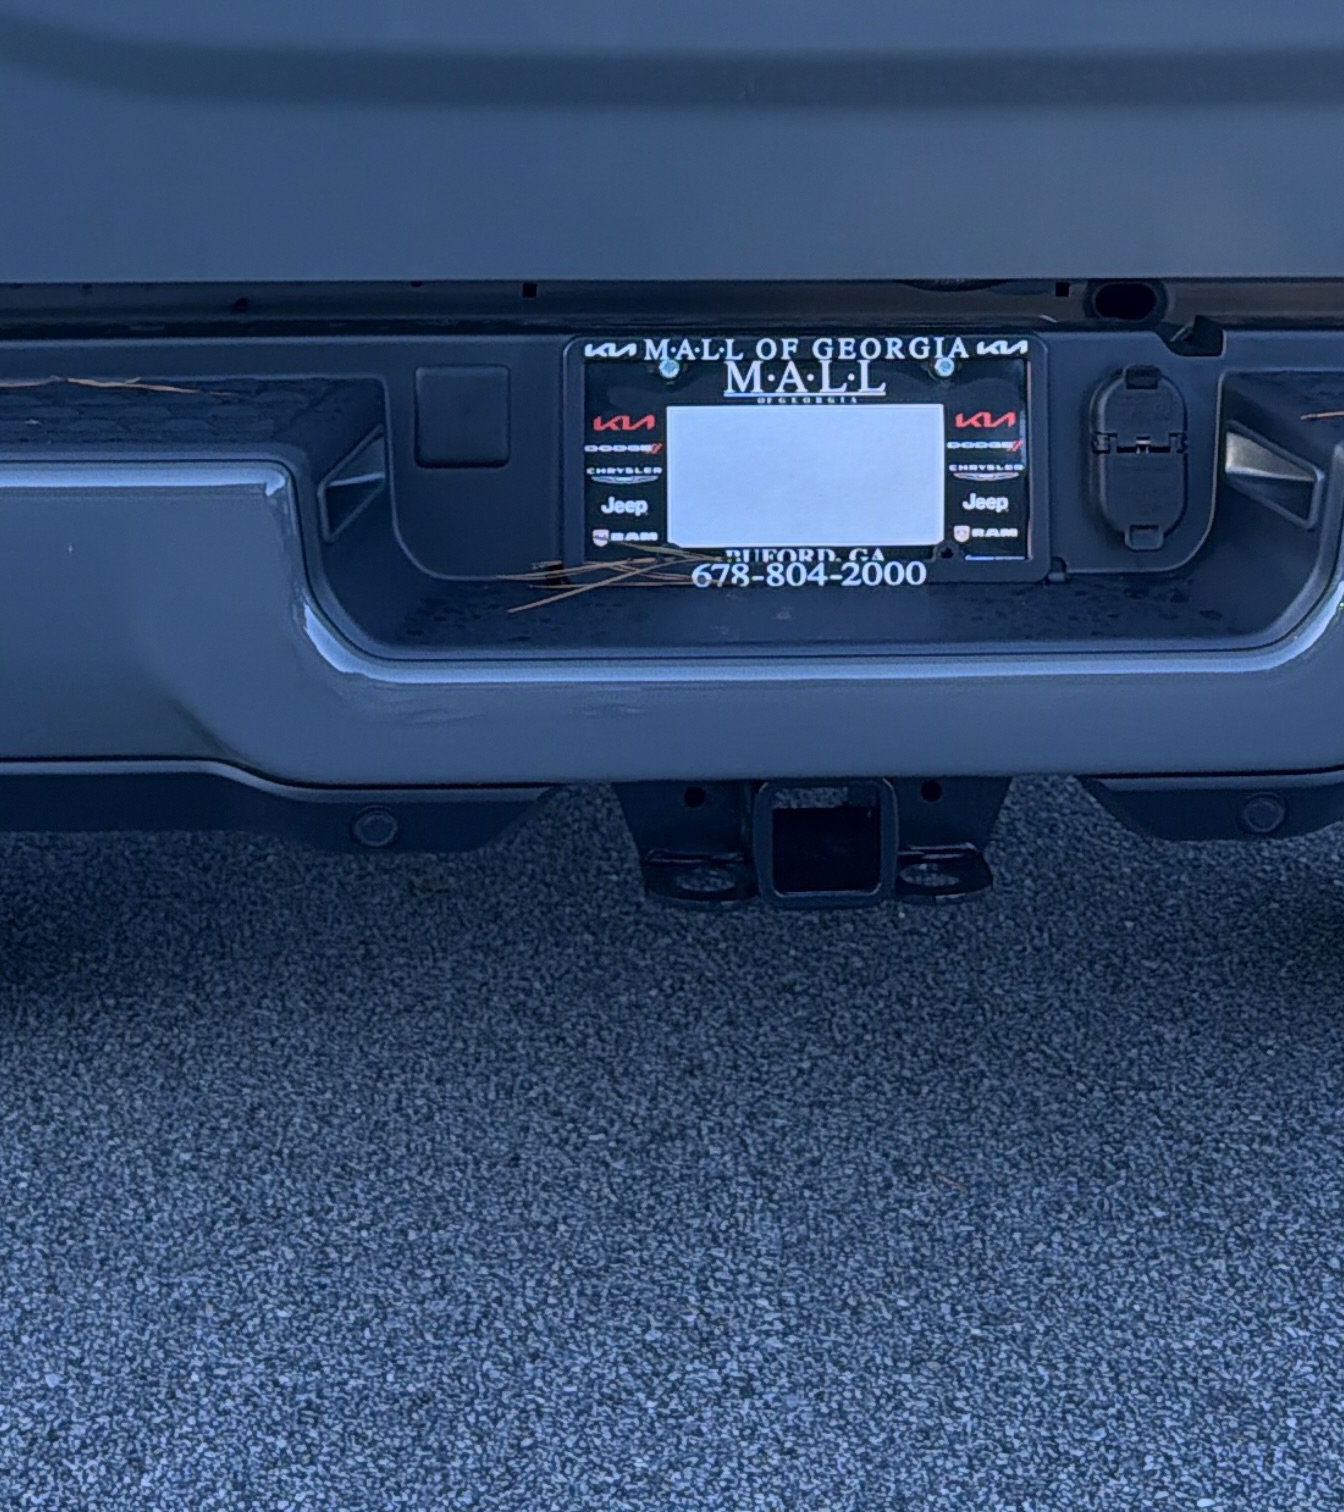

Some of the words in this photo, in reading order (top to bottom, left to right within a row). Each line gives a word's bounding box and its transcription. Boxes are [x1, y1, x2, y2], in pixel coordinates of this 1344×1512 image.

[756, 337, 799, 360] OF
[812, 336, 970, 360] GEORGIA
[586, 467, 663, 475] CHRYSLER
[600, 495, 649, 517] Jeep
[962, 492, 1009, 513] Jeep
[610, 532, 659, 541] RAM
[971, 528, 1018, 537] RAM
[690, 561, 927, 588] 678-804-2000
